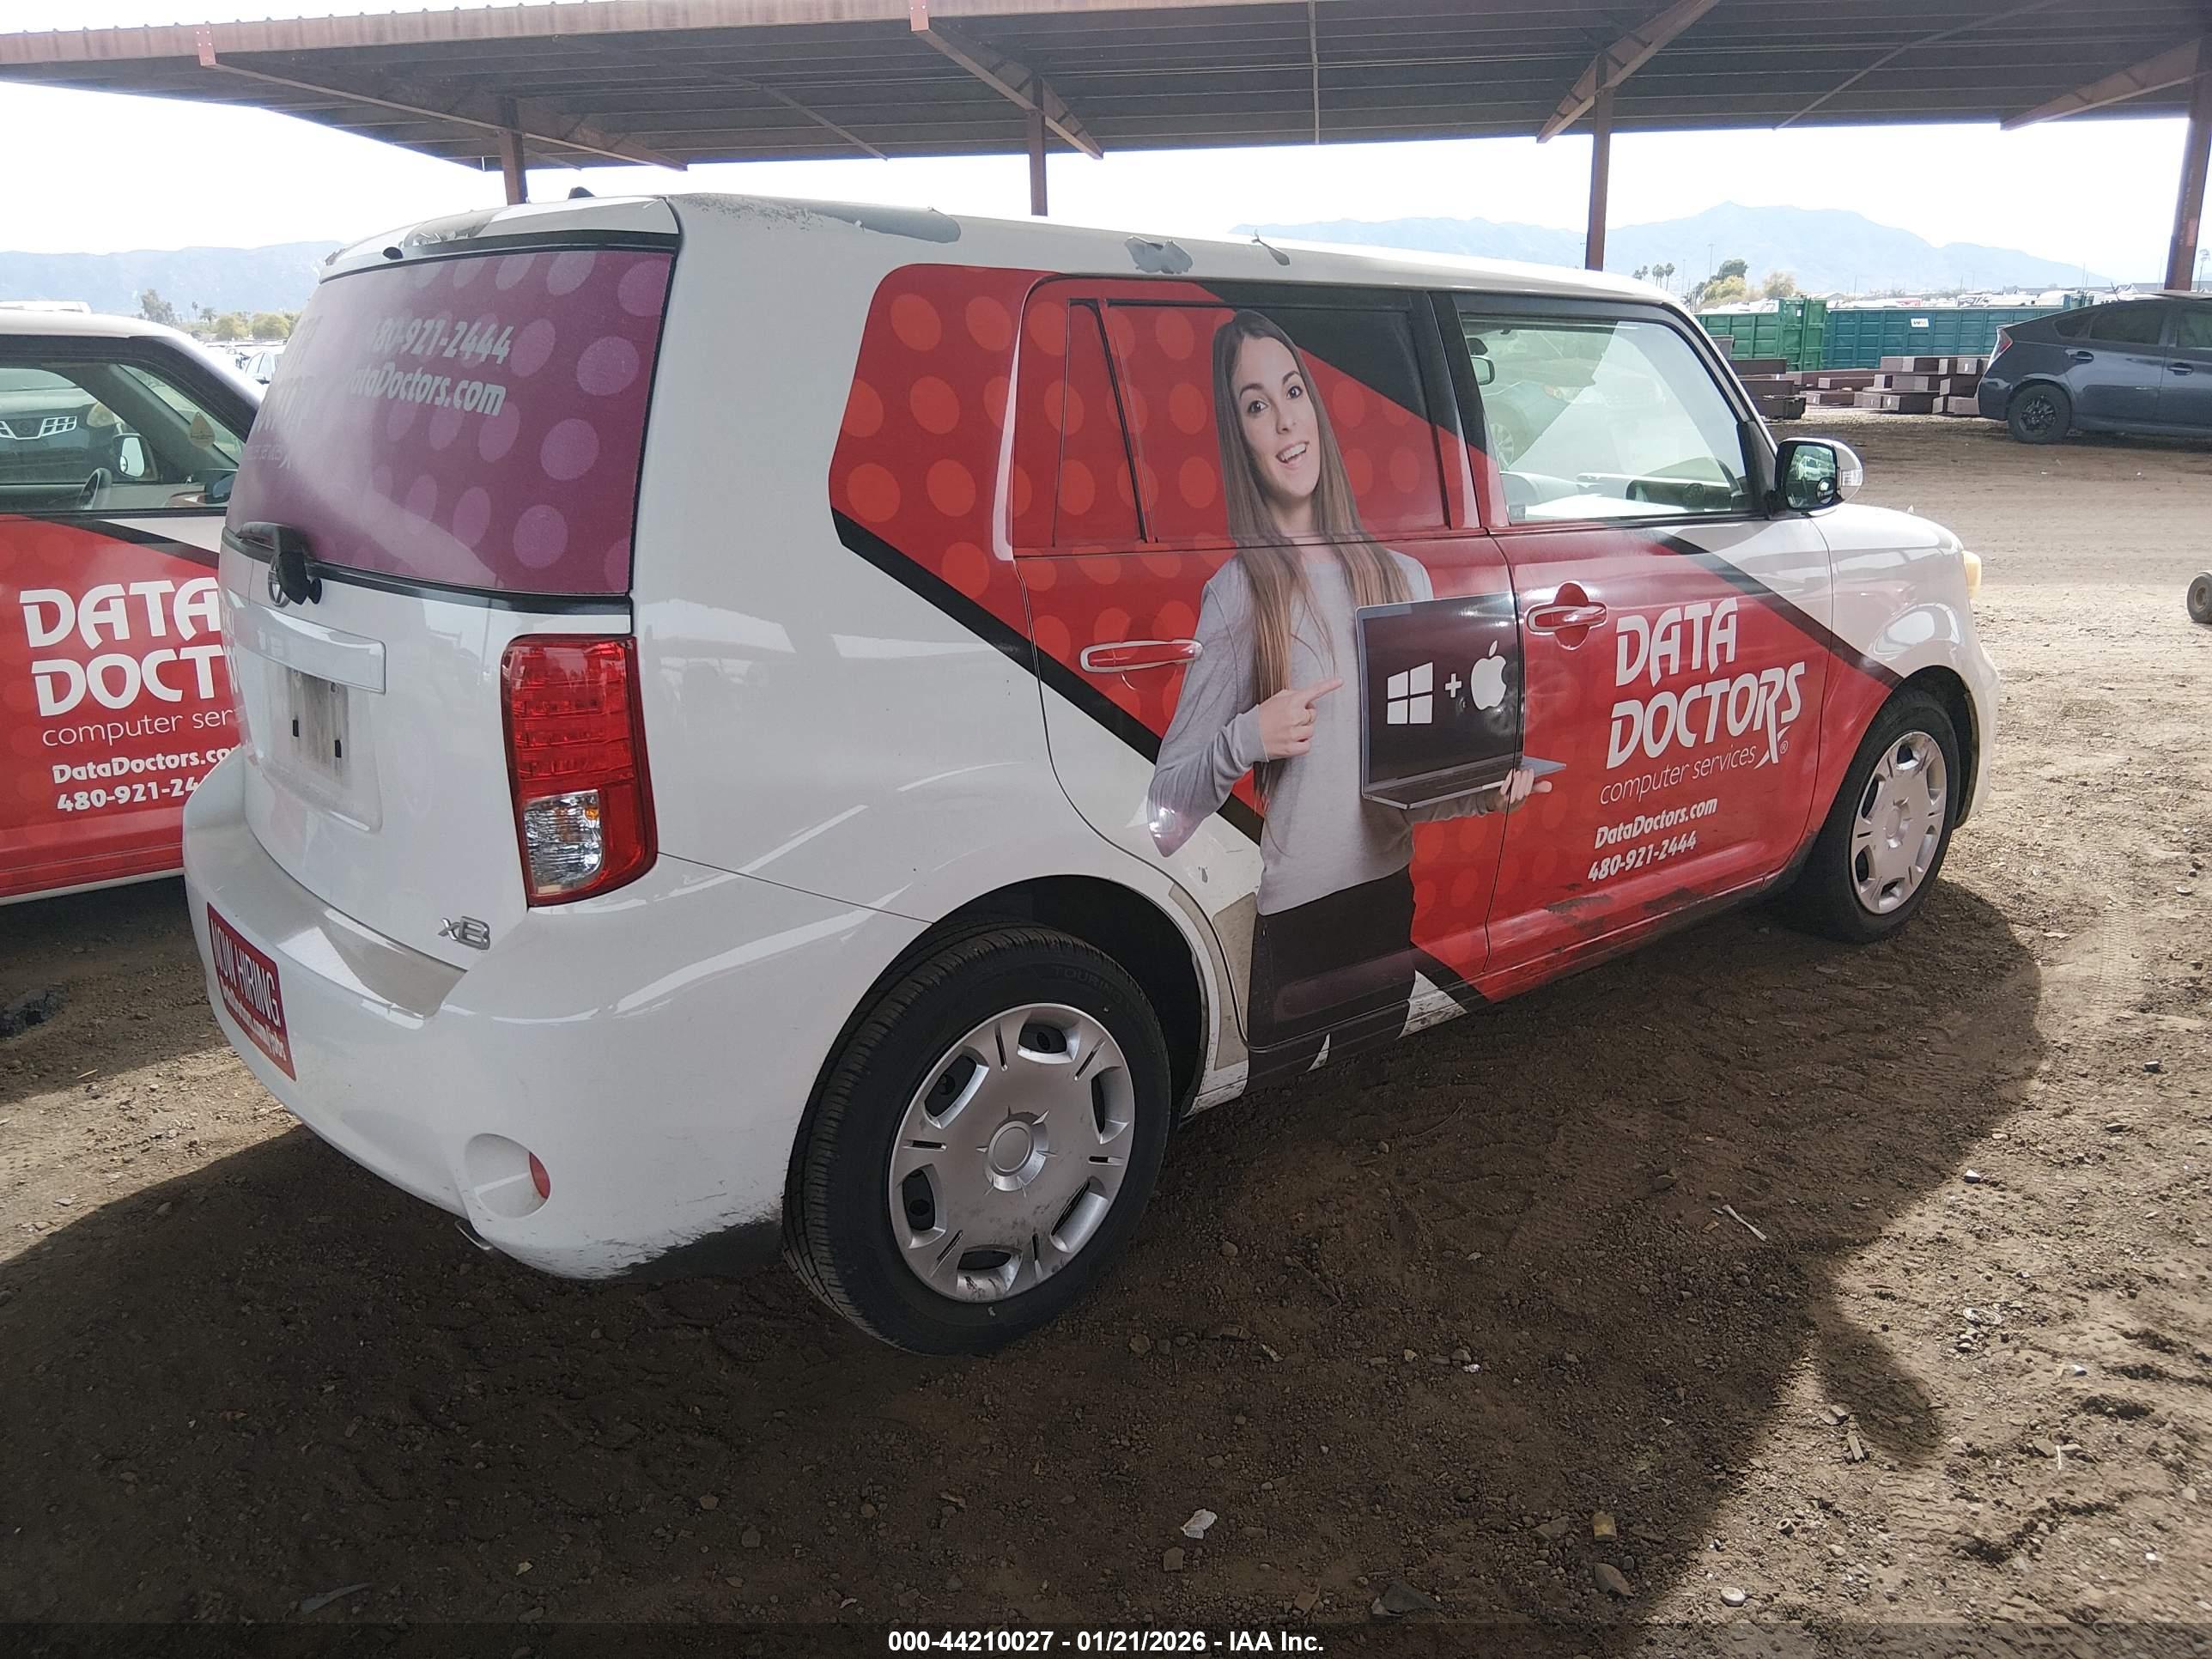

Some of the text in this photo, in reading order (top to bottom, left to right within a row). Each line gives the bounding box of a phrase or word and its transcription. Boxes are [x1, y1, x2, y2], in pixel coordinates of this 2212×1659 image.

[347, 361, 507, 416] ataDoctors.com
[19, 576, 222, 650] DATA
[1615, 597, 1738, 687] DATA
[31, 644, 225, 717] DOCT
[42, 714, 184, 746] computer
[1606, 661, 1805, 770] DOCTORS
[52, 747, 235, 785] DataDoctors.co
[57, 775, 206, 812] 480-921-24
[1600, 744, 1757, 805] computer services
[1594, 798, 1718, 850] DataDoctors.com
[1587, 830, 1698, 882] 480-921-2444
[210, 917, 238, 988] NOW
[234, 944, 282, 1028] HIRING
